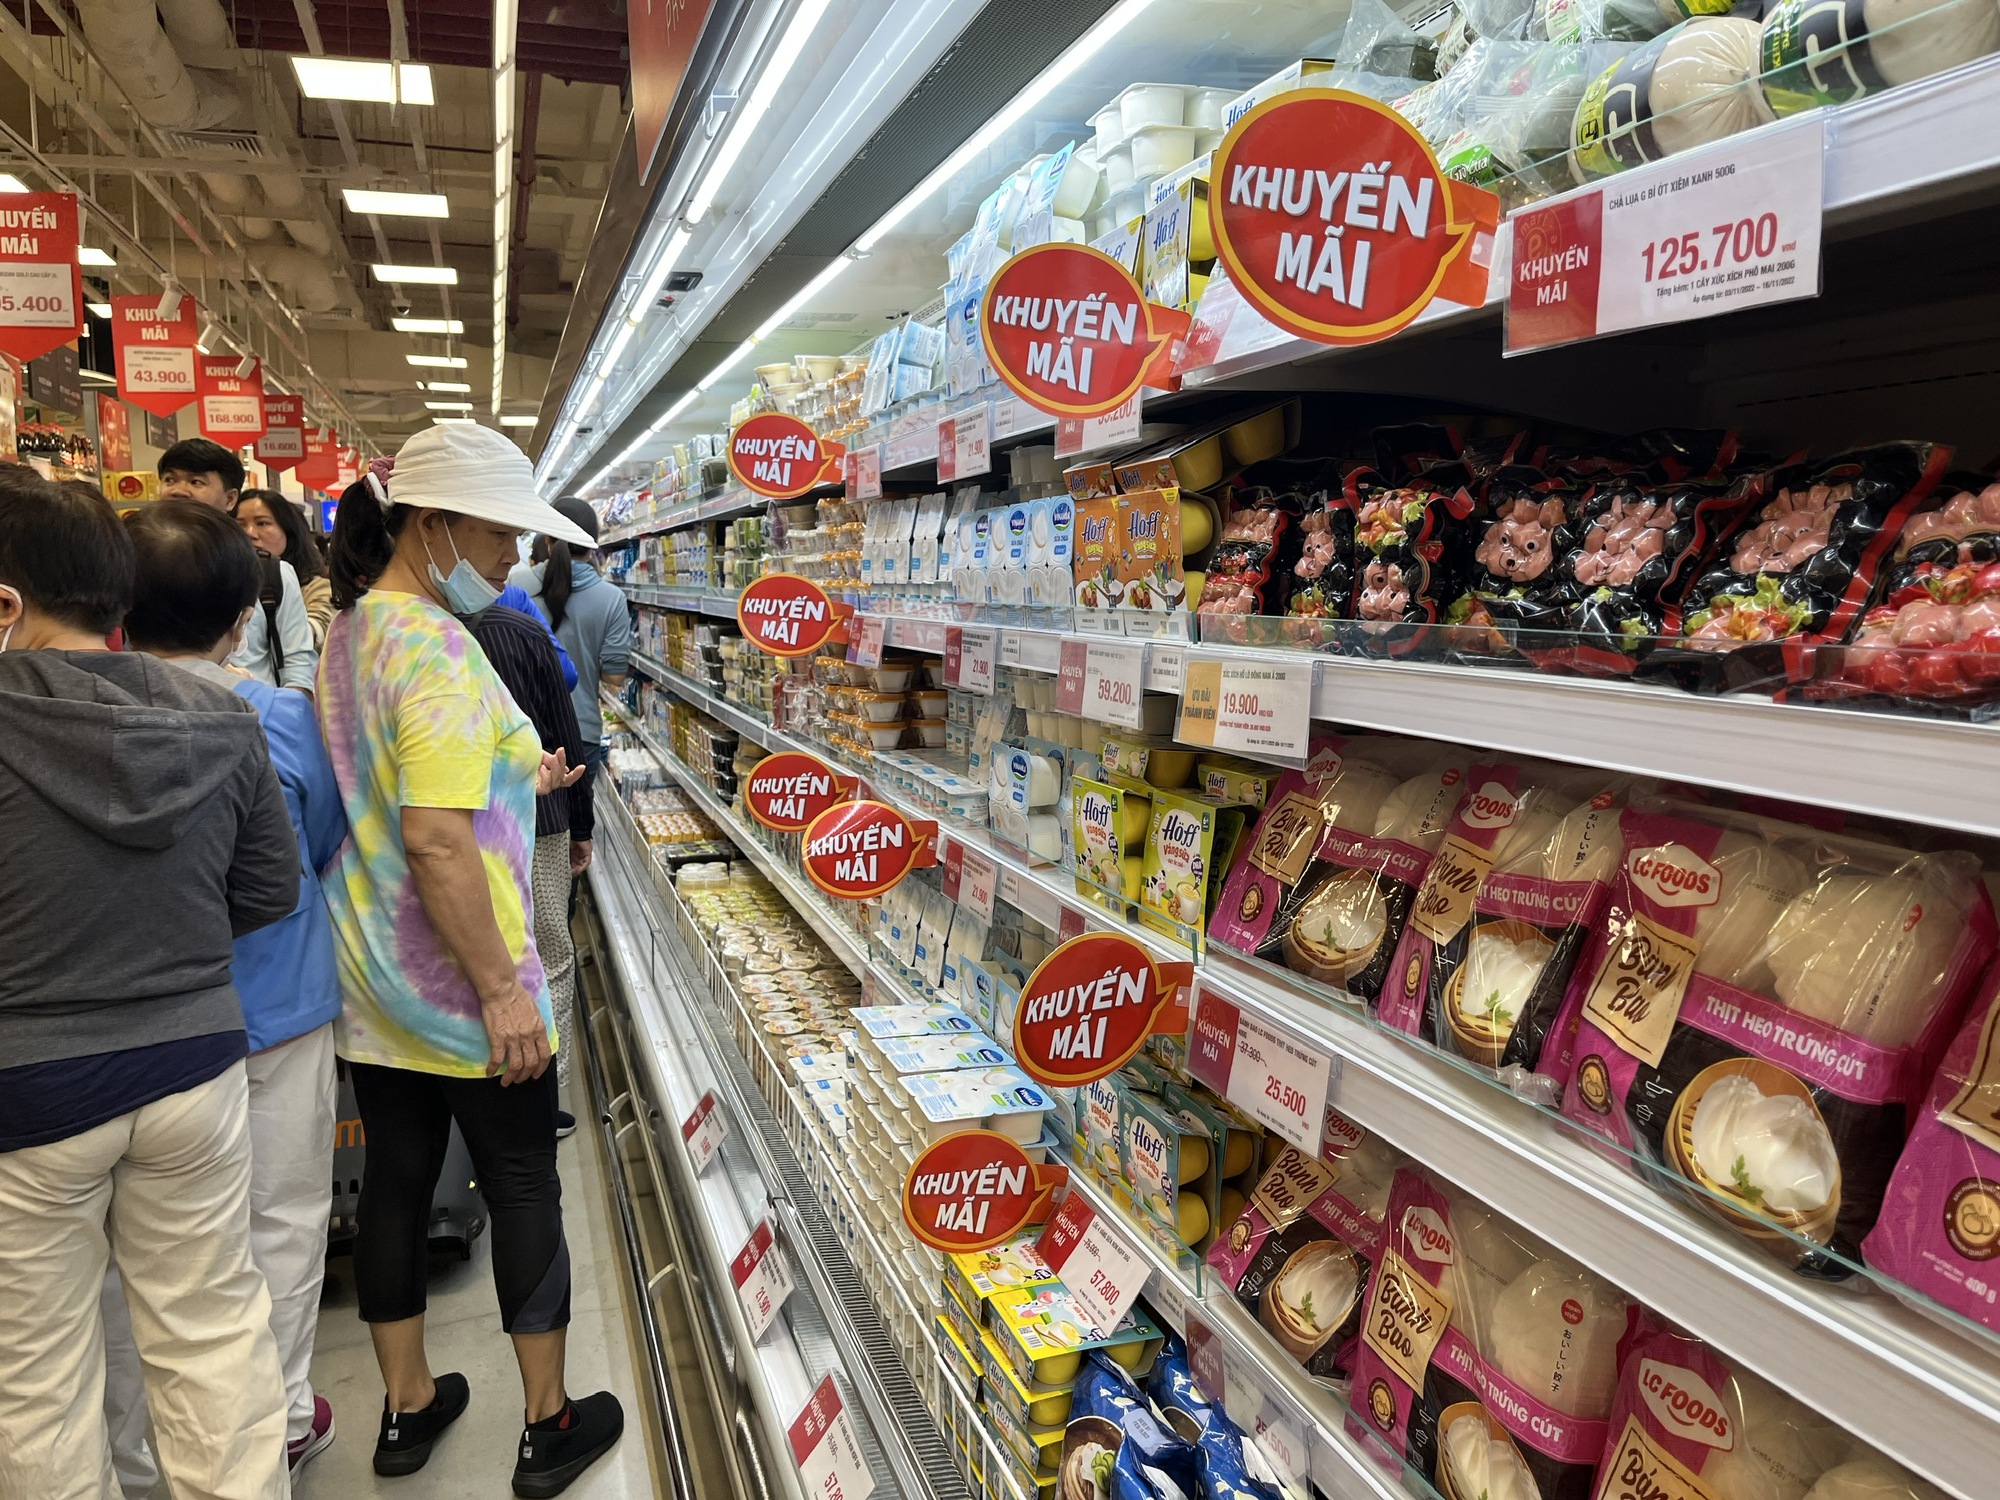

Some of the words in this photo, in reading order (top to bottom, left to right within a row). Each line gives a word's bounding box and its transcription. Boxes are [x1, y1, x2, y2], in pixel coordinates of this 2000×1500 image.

[1230, 161, 1434, 239] KHUYẾN
[1609, 197, 1623, 210] CHẢ
[1625, 192, 1639, 207] LỤA
[1641, 190, 1646, 201] G
[1671, 178, 1689, 193] XIÊM
[1692, 172, 1713, 185] XANH
[1715, 164, 1735, 179] 500G
[1, 233, 38, 255] MÃI
[1154, 209, 1179, 252] Höff
[1520, 244, 1588, 281] KHUYẾN
[1642, 212, 1778, 283] 125.700
[1274, 225, 1371, 310] MÃI
[1691, 281, 1694, 290] 1
[1712, 274, 1725, 286] XÚC
[1727, 269, 1743, 282] XÍCH
[1760, 264, 1775, 275] MAI
[1776, 260, 1795, 272] 200G
[0, 295, 62, 312] 5.400
[1537, 279, 1567, 307] MÃI
[141, 325, 168, 340] MÃI
[993, 292, 1138, 345] KHUYẾN
[134, 370, 186, 383] 43.900
[1026, 336, 1094, 395] MÃI
[209, 414, 254, 423] 168.900
[735, 435, 816, 461] KHUYẾN
[753, 458, 791, 486] MÃI
[1081, 514, 1109, 544] Höff
[1127, 509, 1161, 540] Höff
[744, 596, 825, 622] KHUYẾN
[760, 618, 800, 646] MÃI
[972, 659, 989, 676] 21.900
[1062, 665, 1082, 679] KHUYẾN
[1065, 680, 1076, 692] MÃI
[1098, 679, 1132, 705] 59.200
[1203, 706, 1216, 720] VIÊN
[1224, 692, 1258, 715] 19.900
[751, 772, 830, 796] KHUYẾN
[1208, 772, 1226, 788] Höff
[768, 794, 805, 820] MÃI
[1083, 798, 1112, 827] Höff
[810, 821, 903, 857] KHUYẾN
[1161, 815, 1200, 847] Höff
[835, 852, 877, 882] MÃI
[1328, 838, 1349, 855] THỊT
[1391, 852, 1419, 871] CÚT
[1632, 856, 1652, 878] LC
[1651, 862, 1711, 894] FOODS
[1490, 887, 1511, 903] HEO
[1512, 890, 1549, 909] TRỨNG
[1024, 965, 1148, 1025] KHUYẾN
[1048, 1012, 1108, 1060] MÃI
[1197, 1018, 1231, 1049] KHUYẾN
[1705, 995, 1741, 1024] THỊT
[1742, 1013, 1774, 1036] HEO
[1774, 1026, 1838, 1068] TRỨNG
[1838, 1052, 1867, 1082] CÚT
[1202, 1041, 1218, 1062] MÃI
[1088, 1081, 1118, 1113] Höff
[1265, 1075, 1306, 1117] 25.500
[1132, 1121, 1165, 1162] Höff
[1327, 1115, 1361, 1142] FOODS
[913, 1160, 1027, 1196] KHUYẾN
[1276, 1148, 1320, 1194] Bánh
[1261, 1172, 1298, 1209] Bao
[934, 1196, 990, 1234] MÃI
[1056, 1212, 1080, 1240] KHUYẾN
[1321, 1199, 1341, 1220] THỊT
[1339, 1216, 1359, 1233] HEO
[1052, 1229, 1066, 1247] MÃI
[1090, 1269, 1120, 1305] 57.800
[1381, 1272, 1435, 1335] Bánh
[1377, 1309, 1414, 1359] Bao
[1550, 1329, 1573, 1393] おいしい餃子
[1450, 1344, 1476, 1372] THỊT
[1488, 1383, 1528, 1422] TRỨNG
[1531, 1414, 1564, 1443] CÚT
[1642, 1368, 1659, 1394] LC
[1659, 1380, 1729, 1438] FOODS
[803, 1417, 815, 1437] MÃI
[810, 1395, 827, 1432] KHUYẾN
[1255, 1415, 1291, 1466] 25.500
